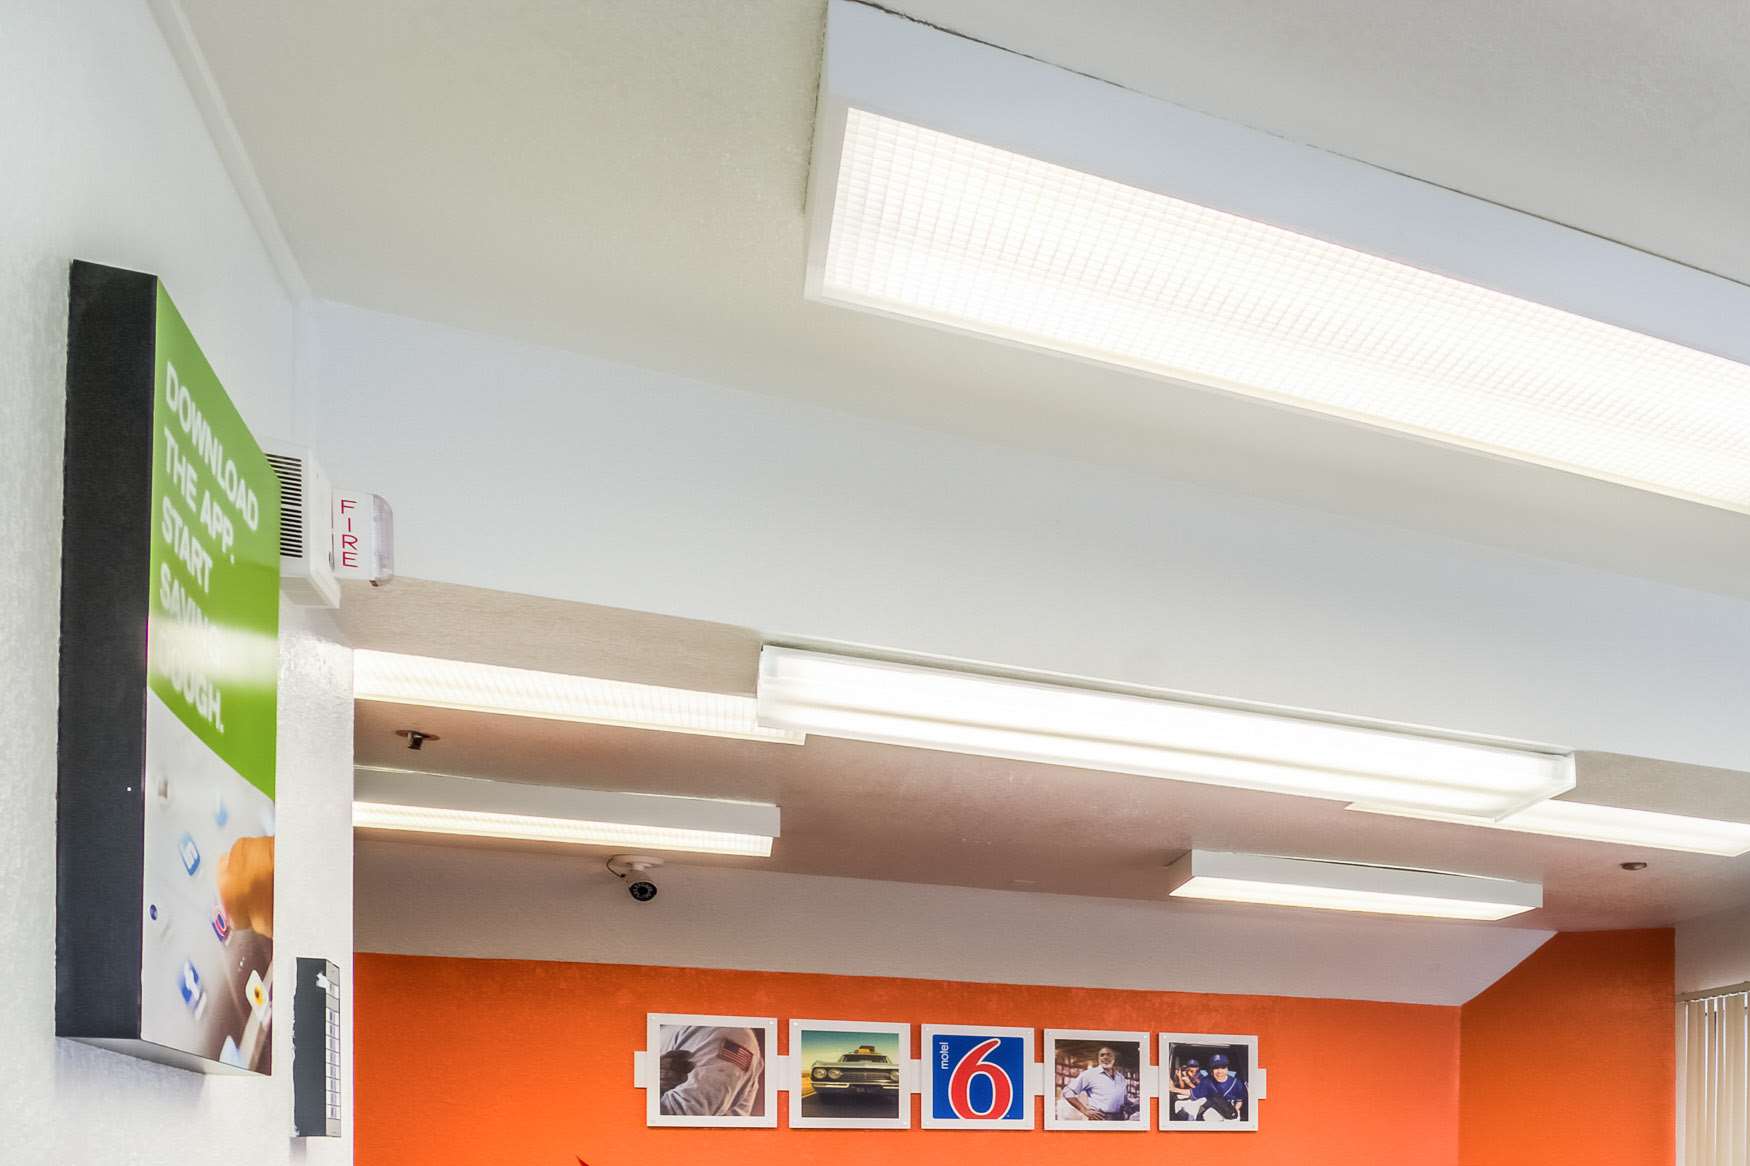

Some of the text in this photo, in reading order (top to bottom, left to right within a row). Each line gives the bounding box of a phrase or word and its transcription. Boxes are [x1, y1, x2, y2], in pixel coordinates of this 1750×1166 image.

[166, 361, 259, 531] DOWNLOAD
[162, 495, 213, 594] START
[164, 426, 235, 566] THE APP.
[340, 499, 359, 569] FIRE
[939, 1038, 1014, 1120] motel 6
